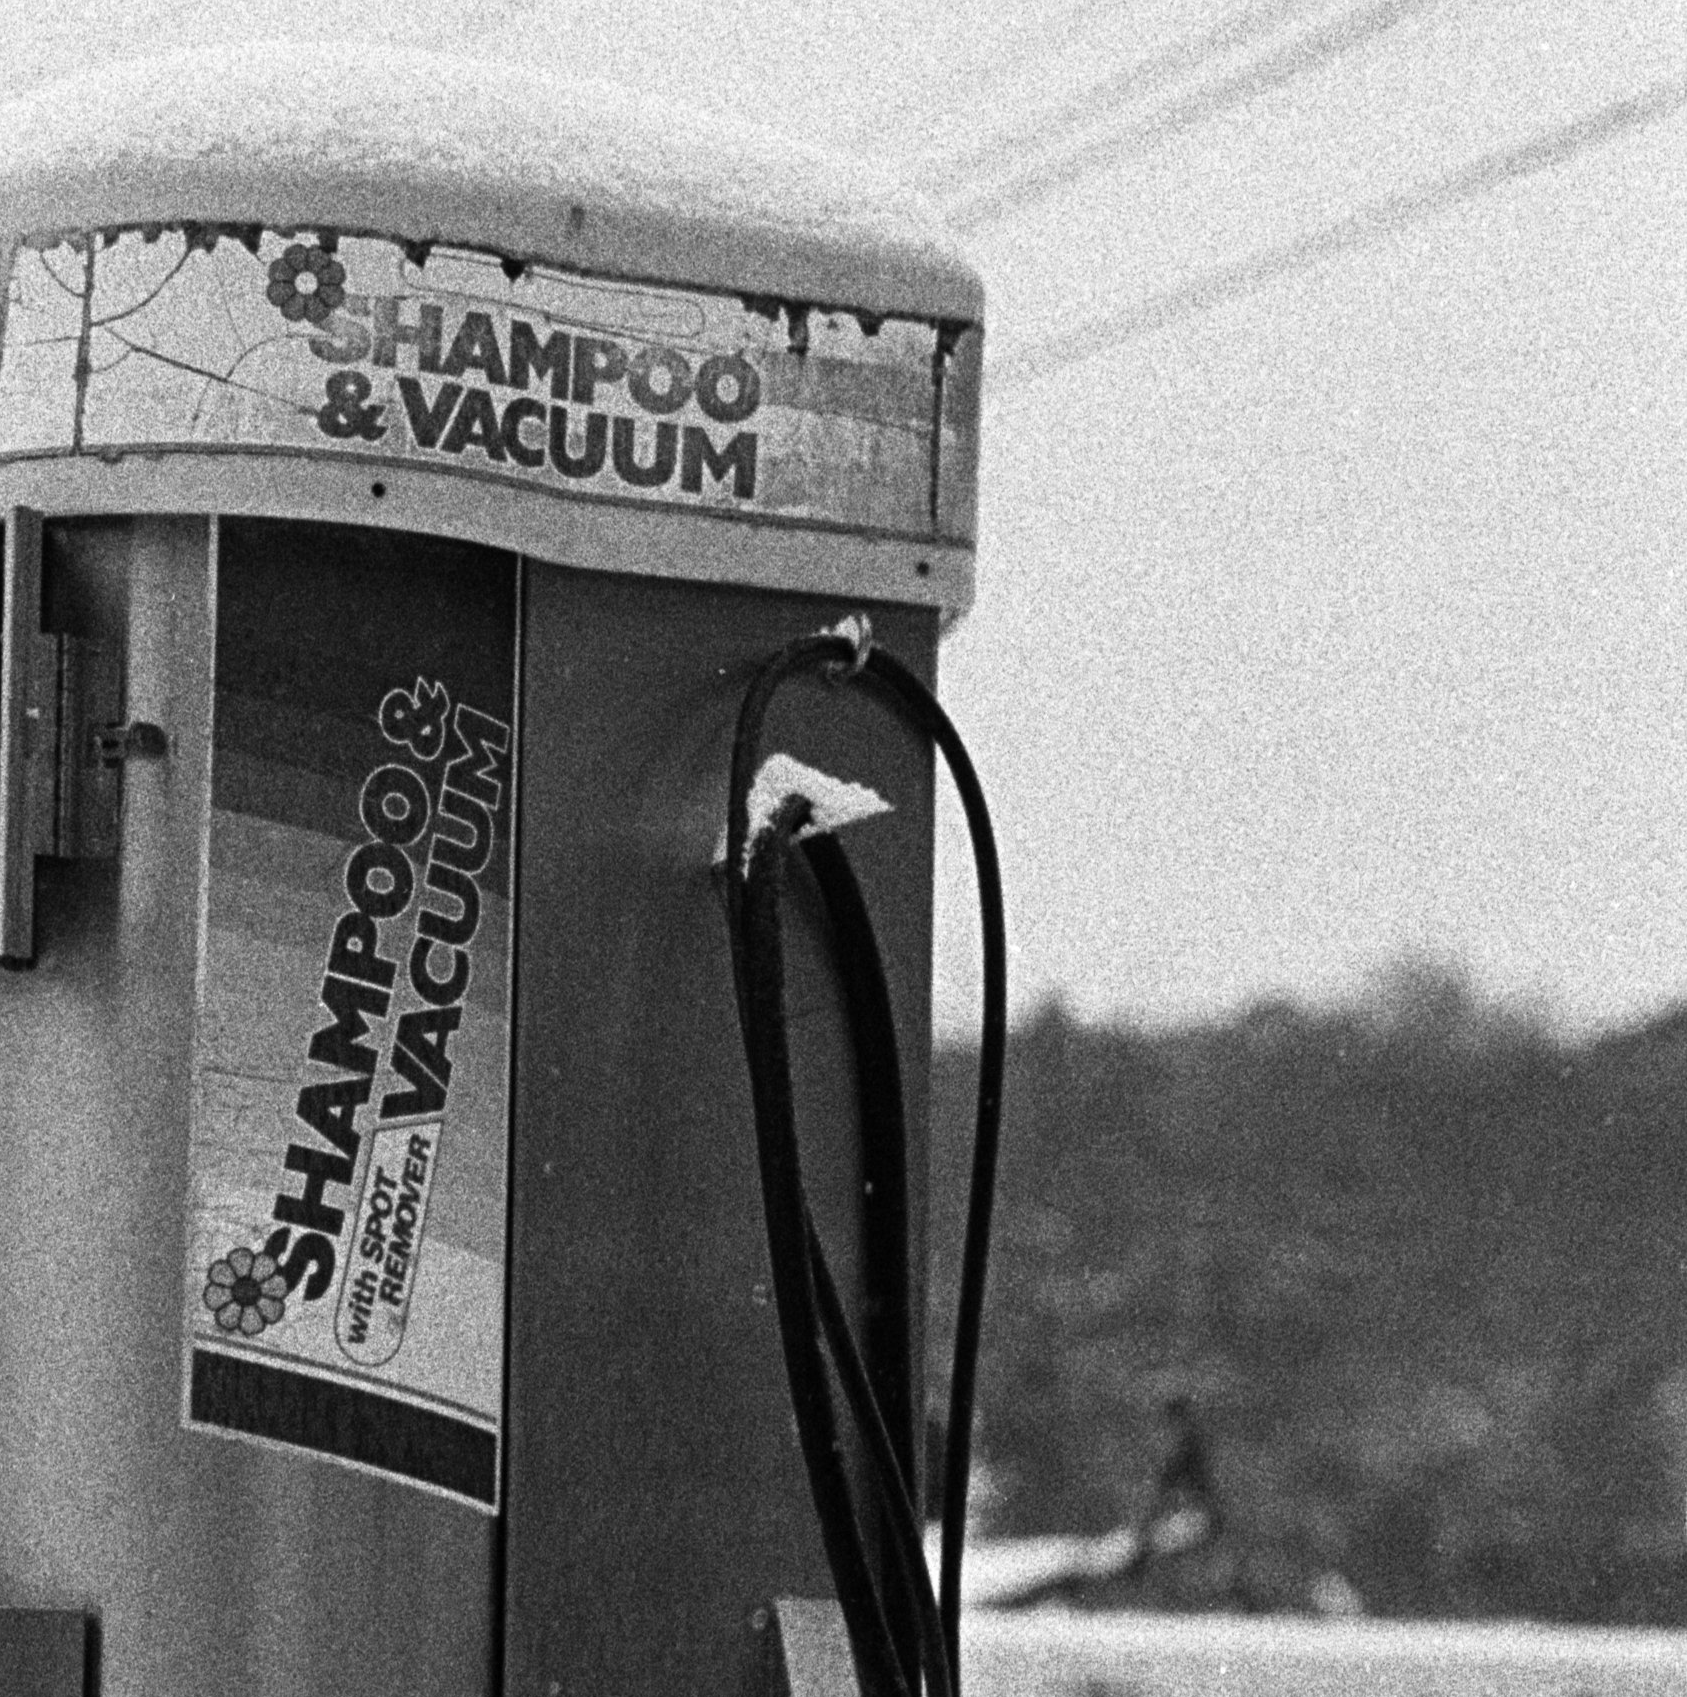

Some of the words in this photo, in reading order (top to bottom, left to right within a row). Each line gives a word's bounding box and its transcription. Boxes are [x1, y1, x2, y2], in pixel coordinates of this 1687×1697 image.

[308, 296, 761, 424] SHAMPOO
[317, 369, 387, 442] &
[397, 376, 759, 501] VACUUM
[379, 703, 511, 1120] VACUUM
[263, 764, 431, 1302] SHAMPOO
[379, 676, 450, 761] &
[359, 1165, 398, 1264] SPOT
[378, 1133, 432, 1307] REMOVER
[348, 1269, 379, 1344] with
